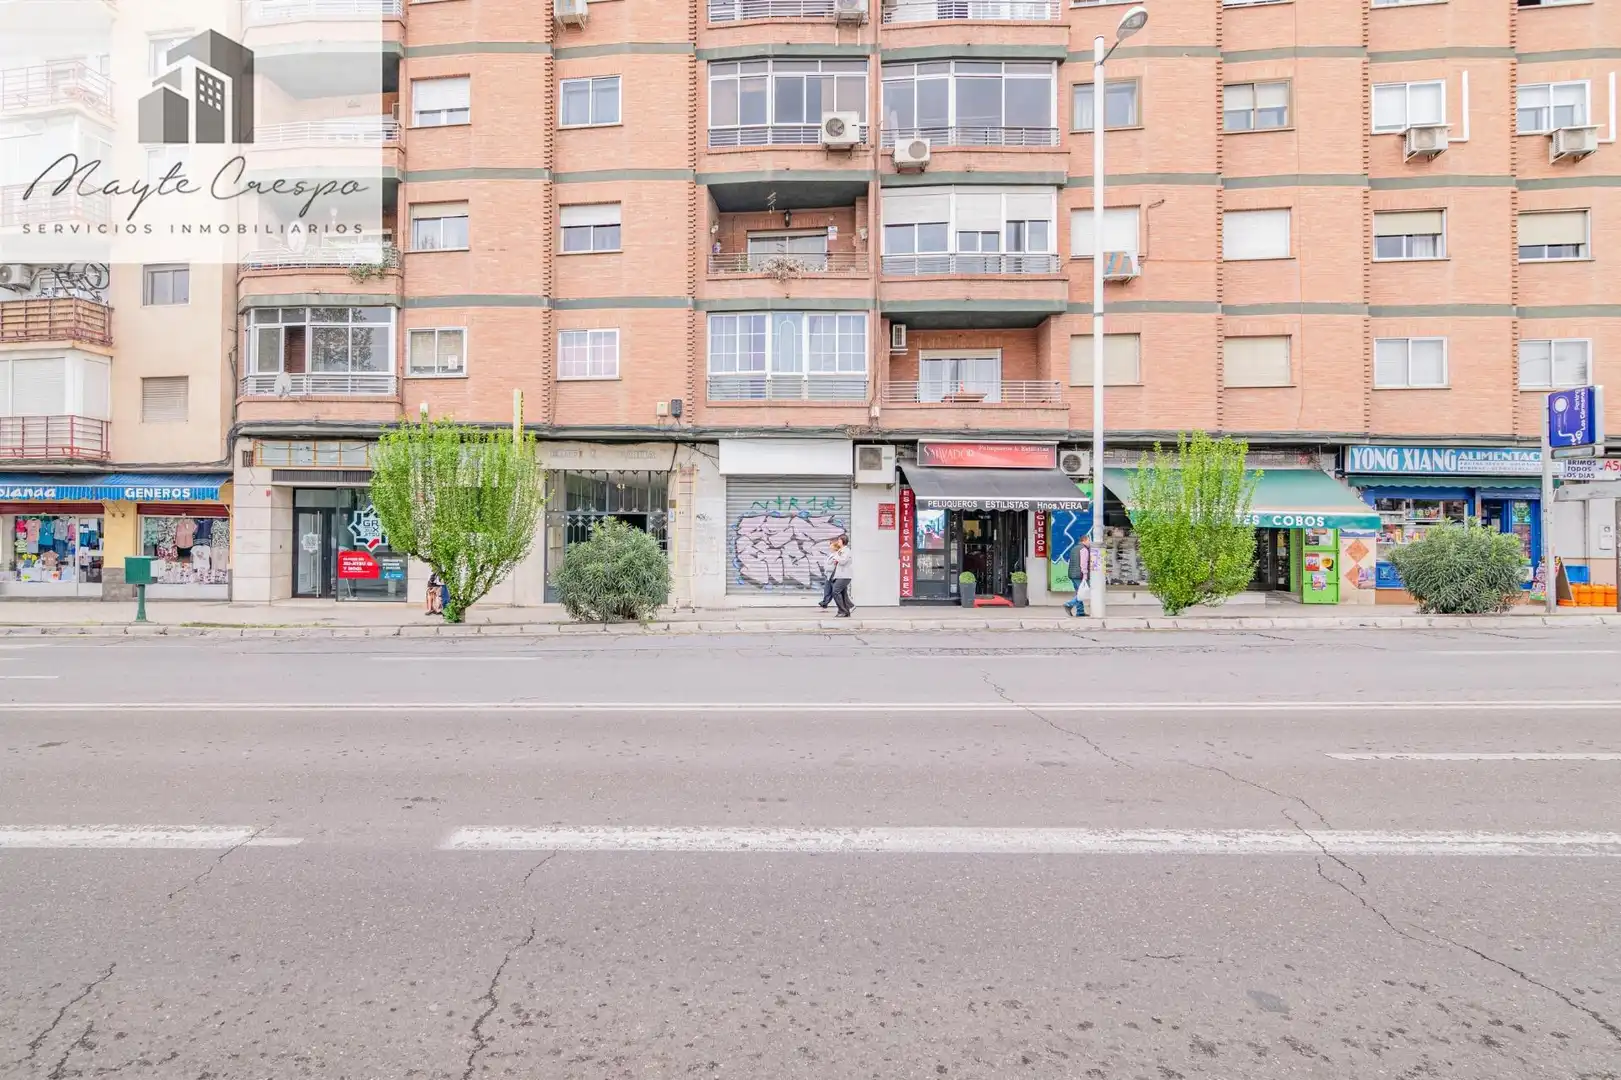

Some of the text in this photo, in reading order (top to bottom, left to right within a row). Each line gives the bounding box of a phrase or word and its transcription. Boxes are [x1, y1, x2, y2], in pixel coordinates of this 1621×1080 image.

[1352, 447, 1398, 470] YONG
[1402, 447, 1457, 471] XIANG
[1604, 460, 1621, 471] AS
[124, 487, 191, 499] GENEROS
[927, 500, 978, 508] PELUQUEROS
[985, 501, 1030, 509] ESTILISTAS
[901, 490, 912, 548] ESTILISTA
[1272, 515, 1325, 527] COBOS
[901, 555, 912, 596] UNISEX
